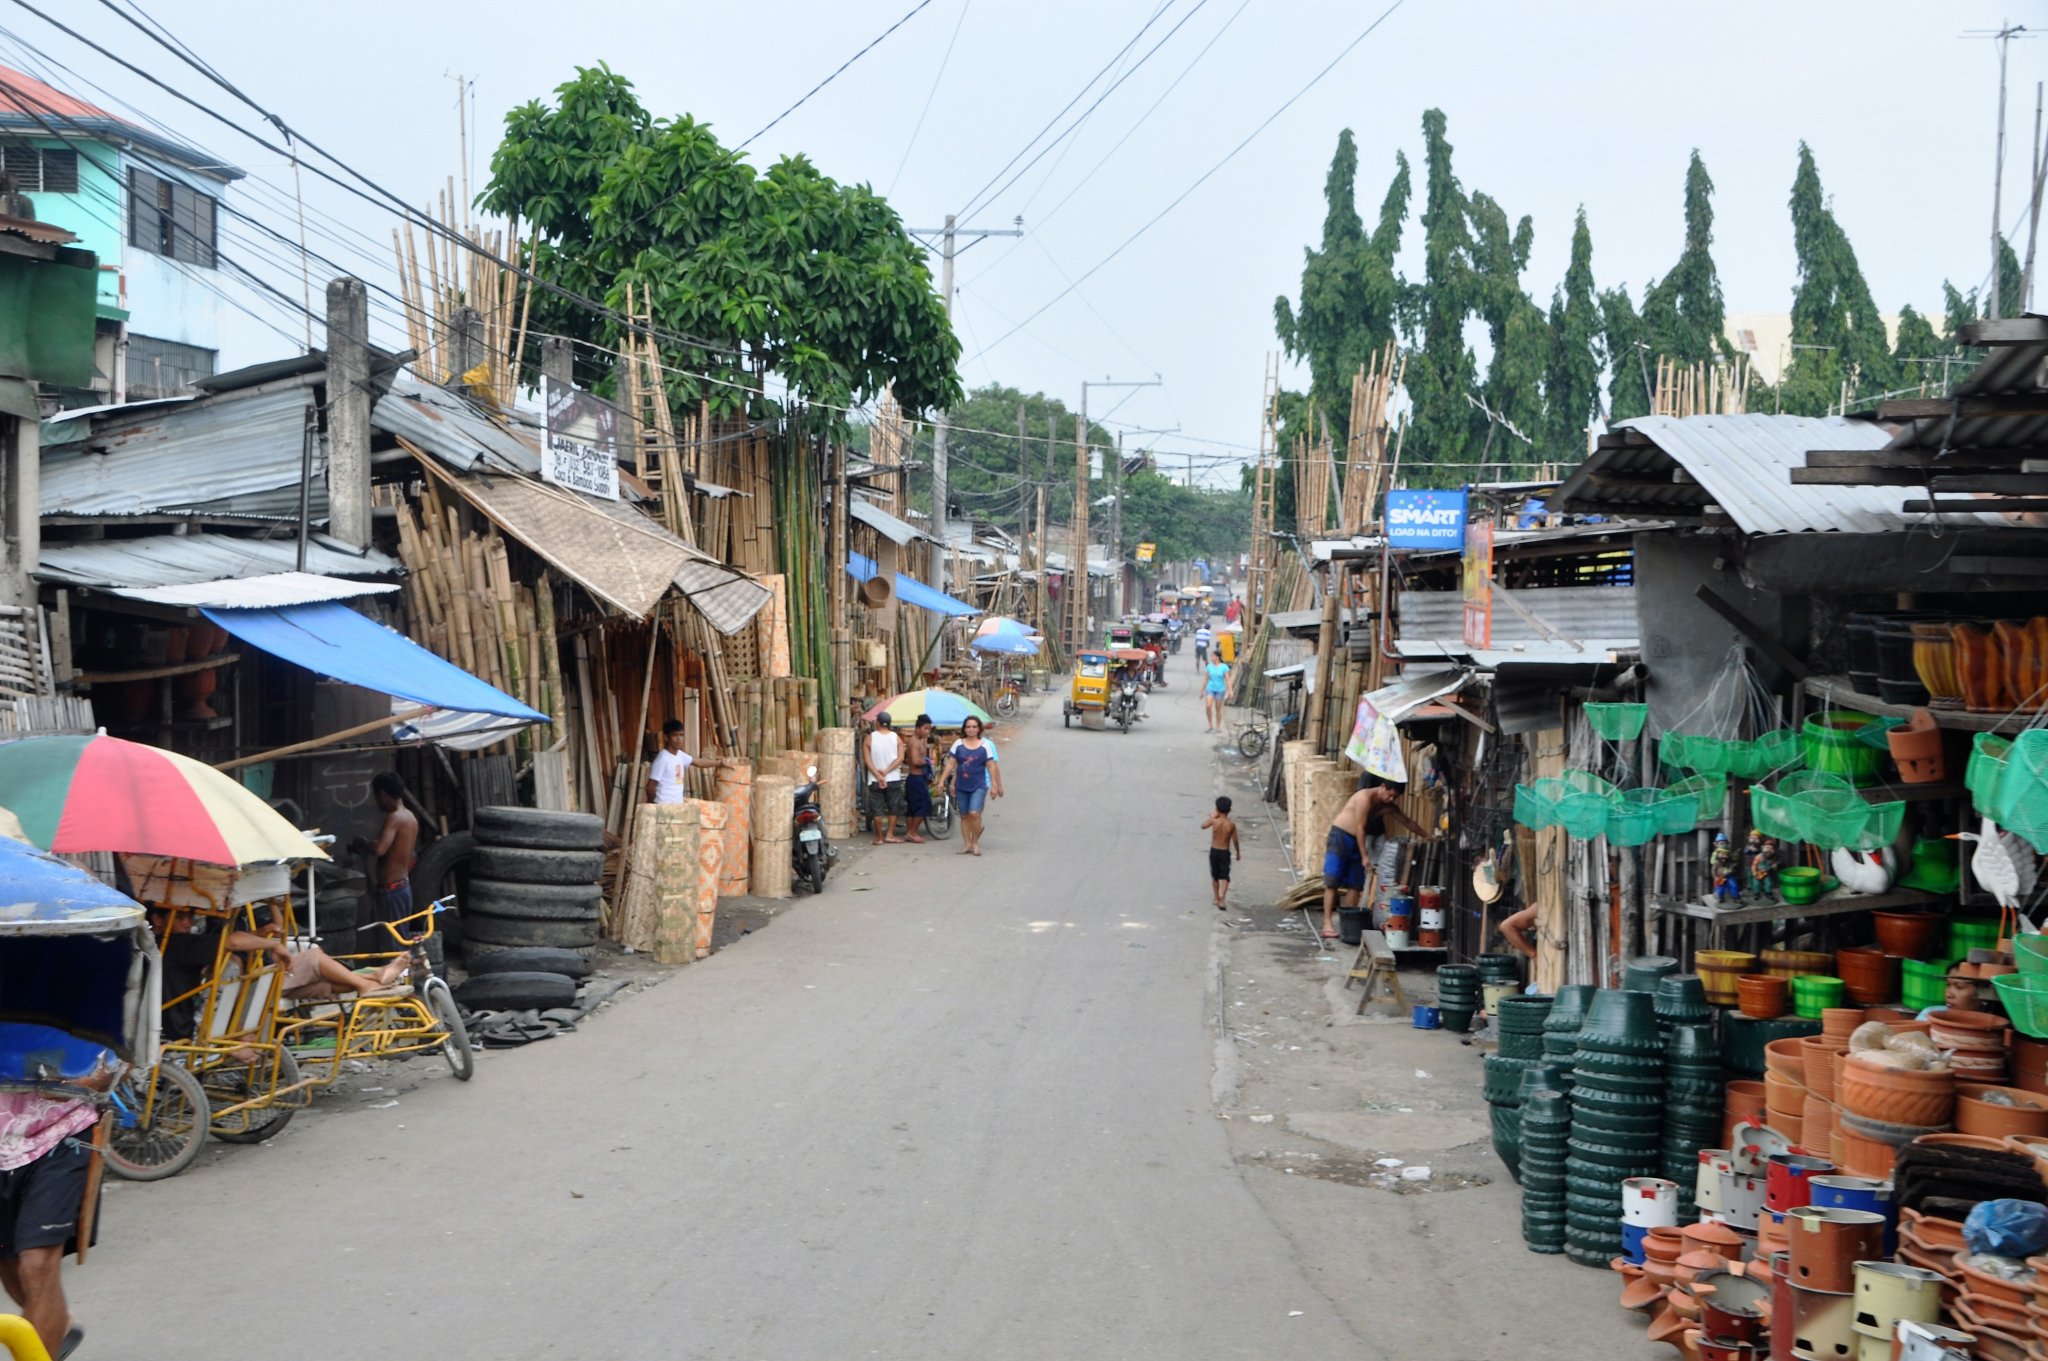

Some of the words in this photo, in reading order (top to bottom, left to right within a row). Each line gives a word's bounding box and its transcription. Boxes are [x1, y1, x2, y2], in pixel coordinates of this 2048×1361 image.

[573, 472, 592, 490] Bamboo
[1389, 507, 1460, 525] SMART
[1390, 528, 1415, 537] LOAD
[1416, 528, 1430, 537] NA
[1431, 528, 1458, 538] DITO!
